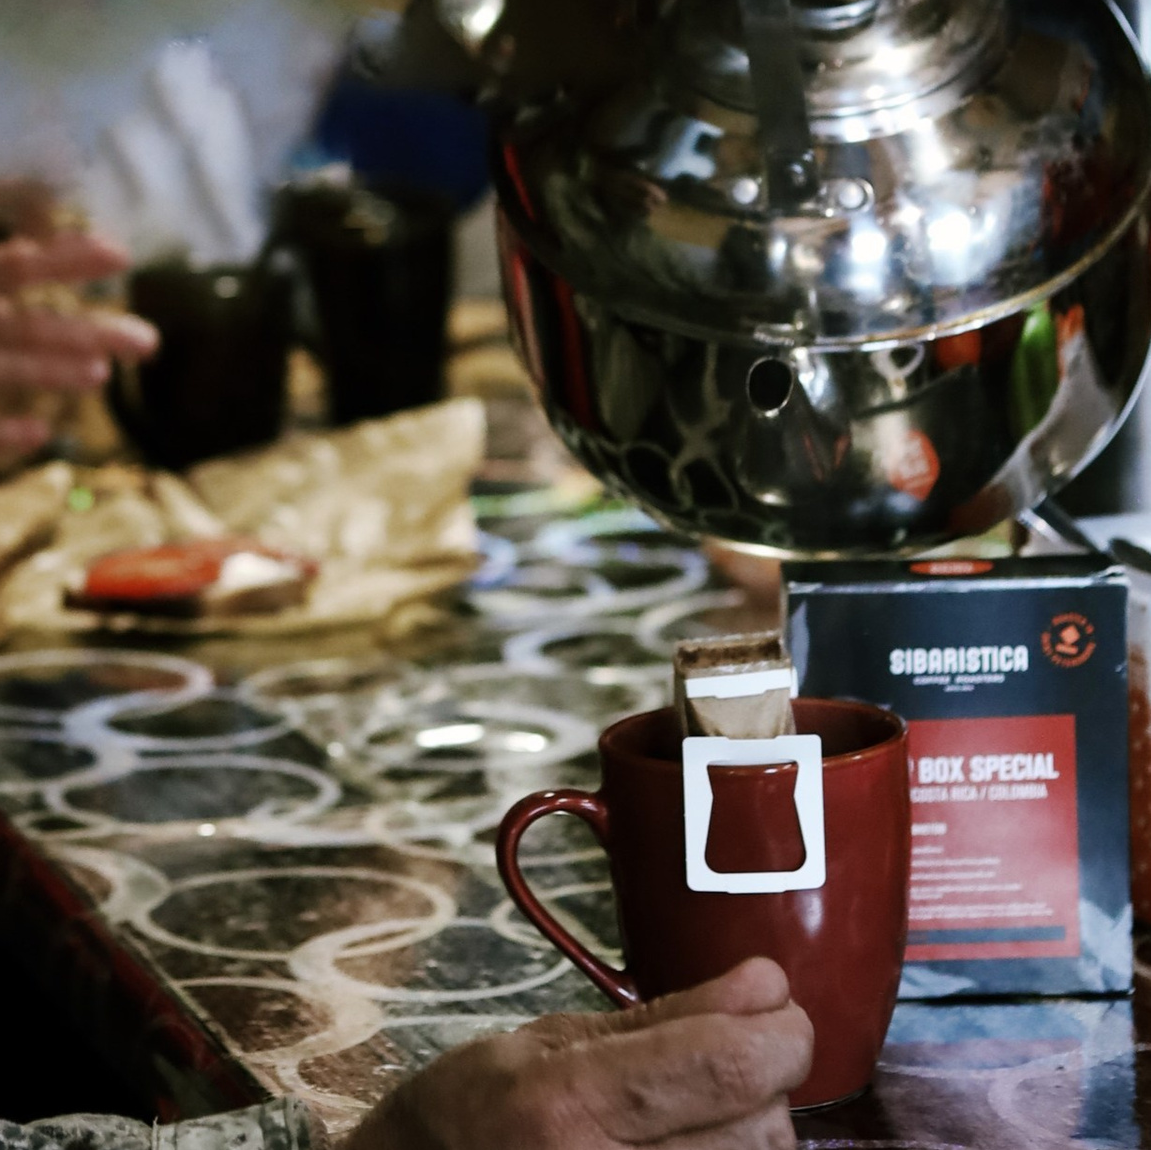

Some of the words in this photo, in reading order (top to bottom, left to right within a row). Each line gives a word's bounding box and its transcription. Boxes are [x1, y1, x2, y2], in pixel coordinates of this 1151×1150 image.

[889, 645, 1029, 675] SIBARISTICA
[917, 755, 966, 784] BOX
[968, 752, 1060, 782] SPECIAL
[951, 785, 978, 801] RICA
[988, 782, 1048, 801] COLOMBIA
